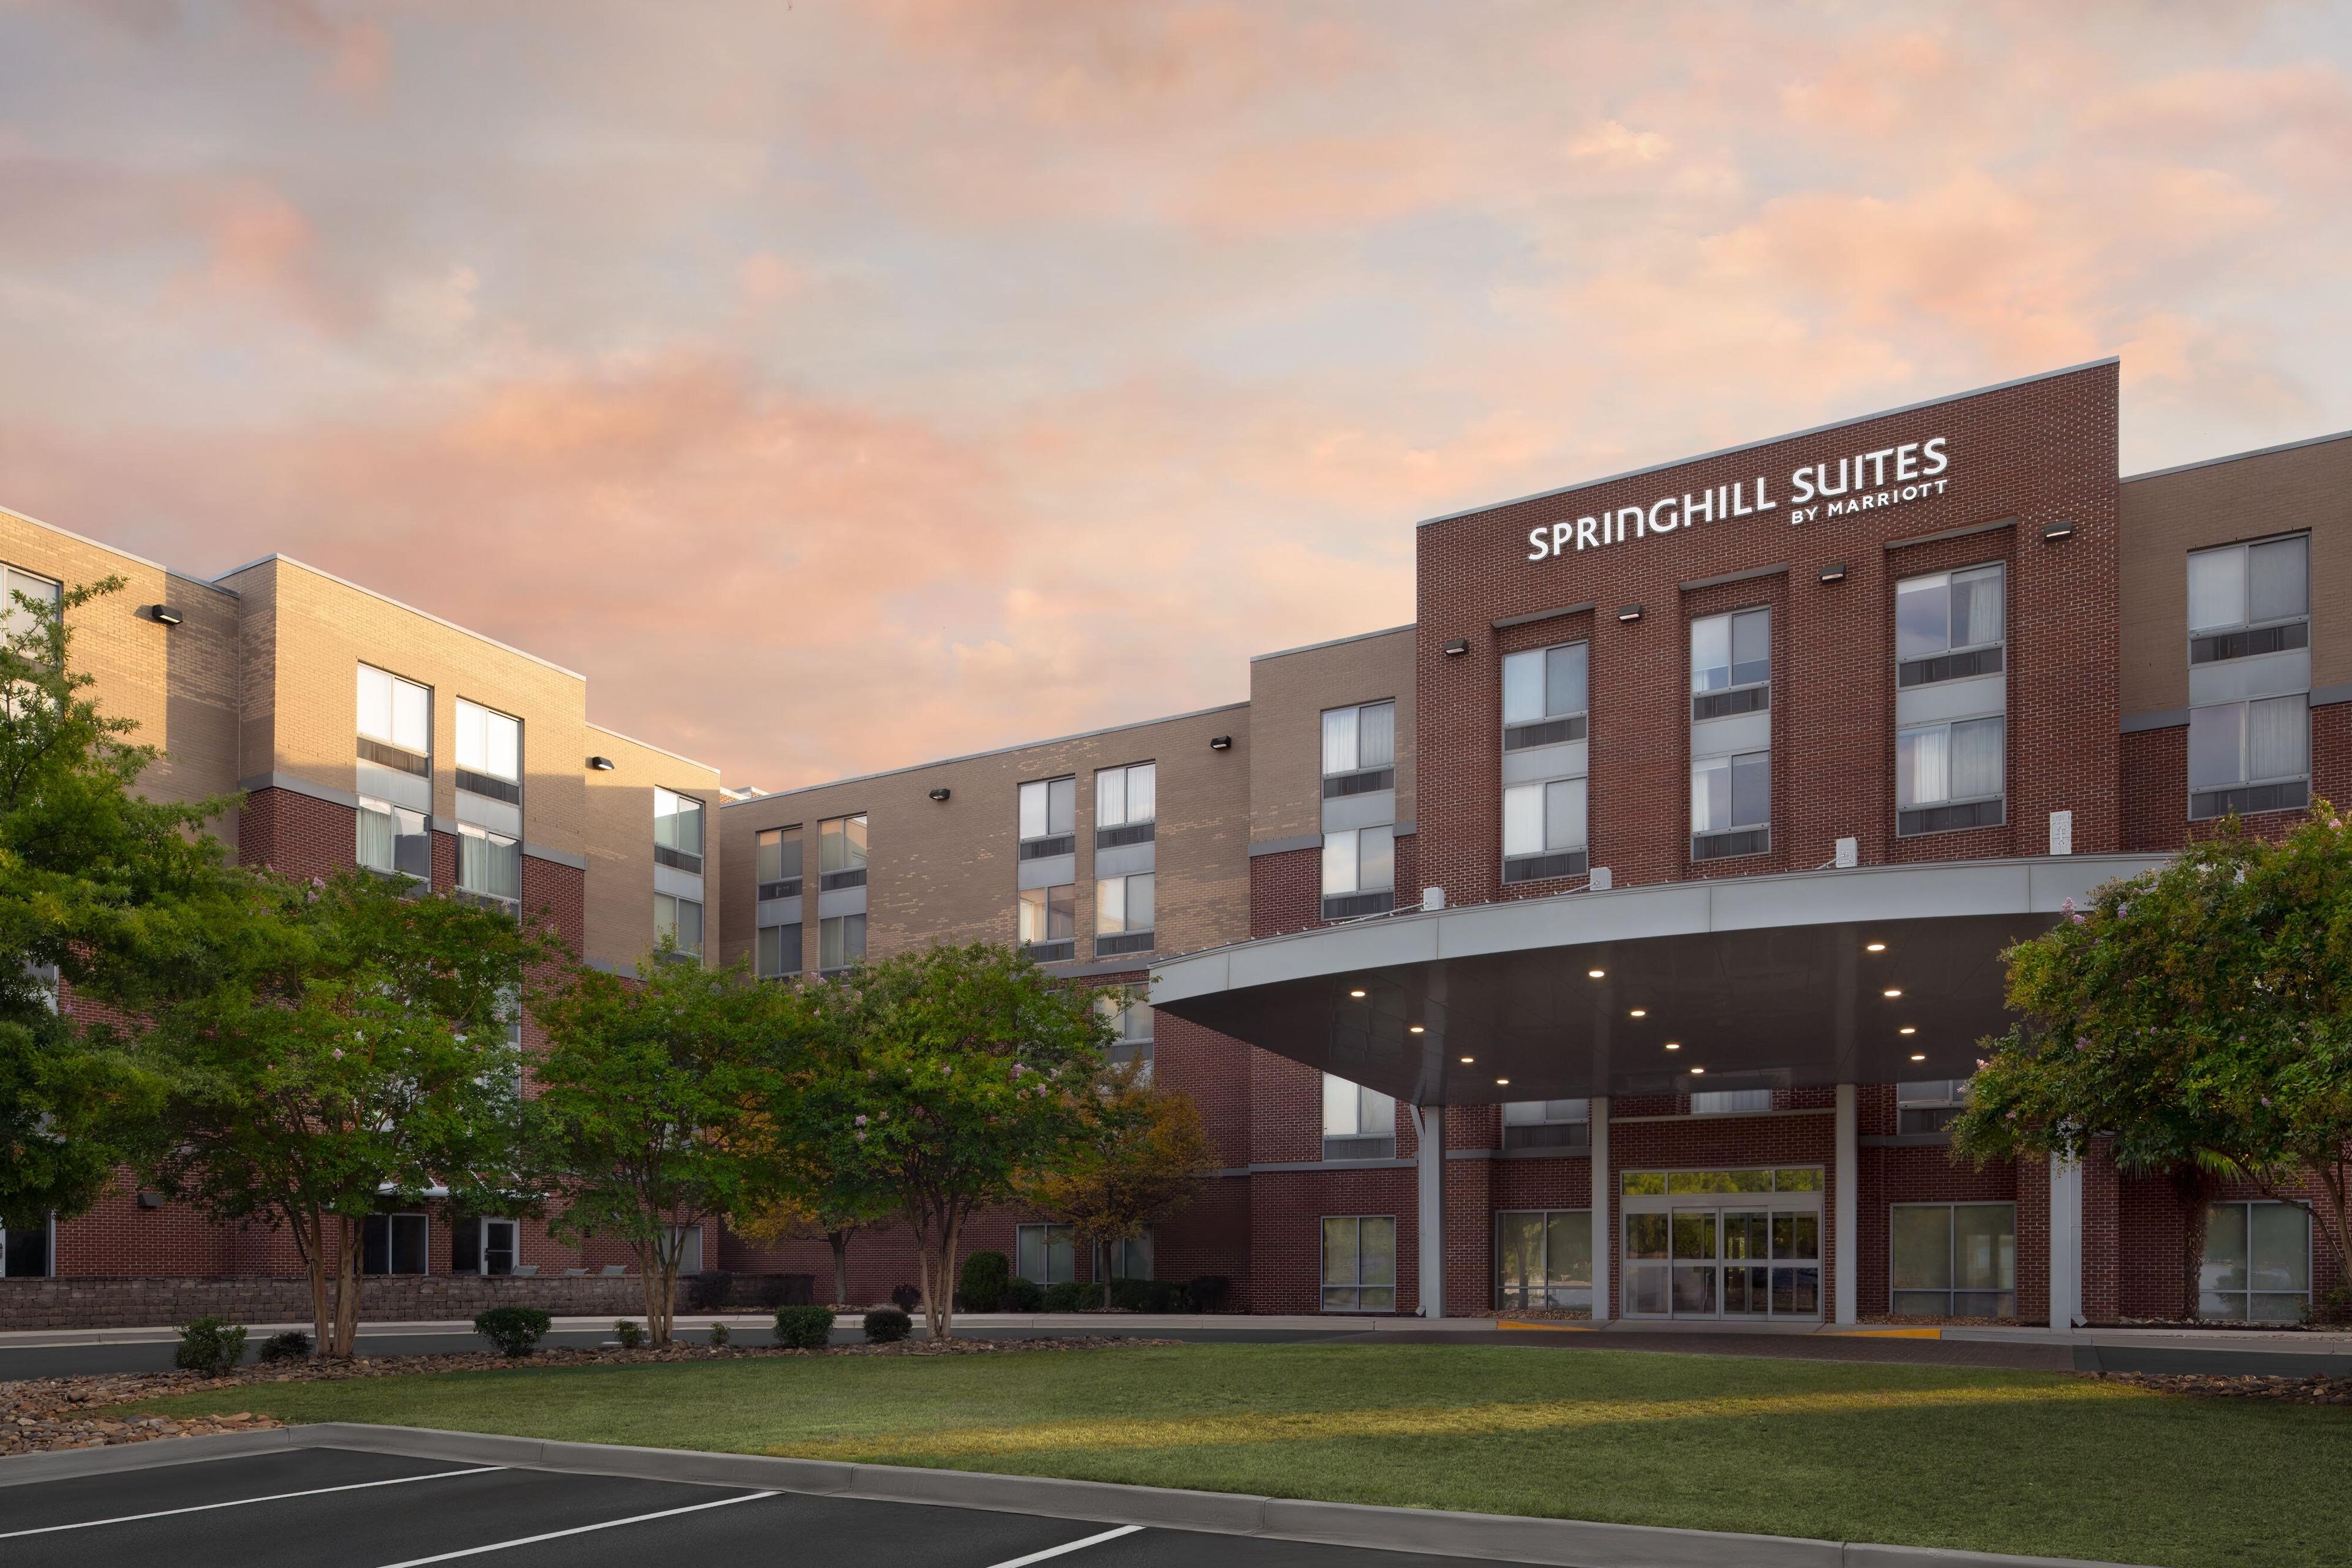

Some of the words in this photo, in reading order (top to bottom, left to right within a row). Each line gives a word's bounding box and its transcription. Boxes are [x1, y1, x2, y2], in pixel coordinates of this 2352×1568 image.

[1528, 477, 1776, 560] SPRINGHILL
[1791, 437, 1948, 503] SUITES
[1792, 507, 1818, 524] BY
[1828, 479, 1948, 517] MARRIOTT
